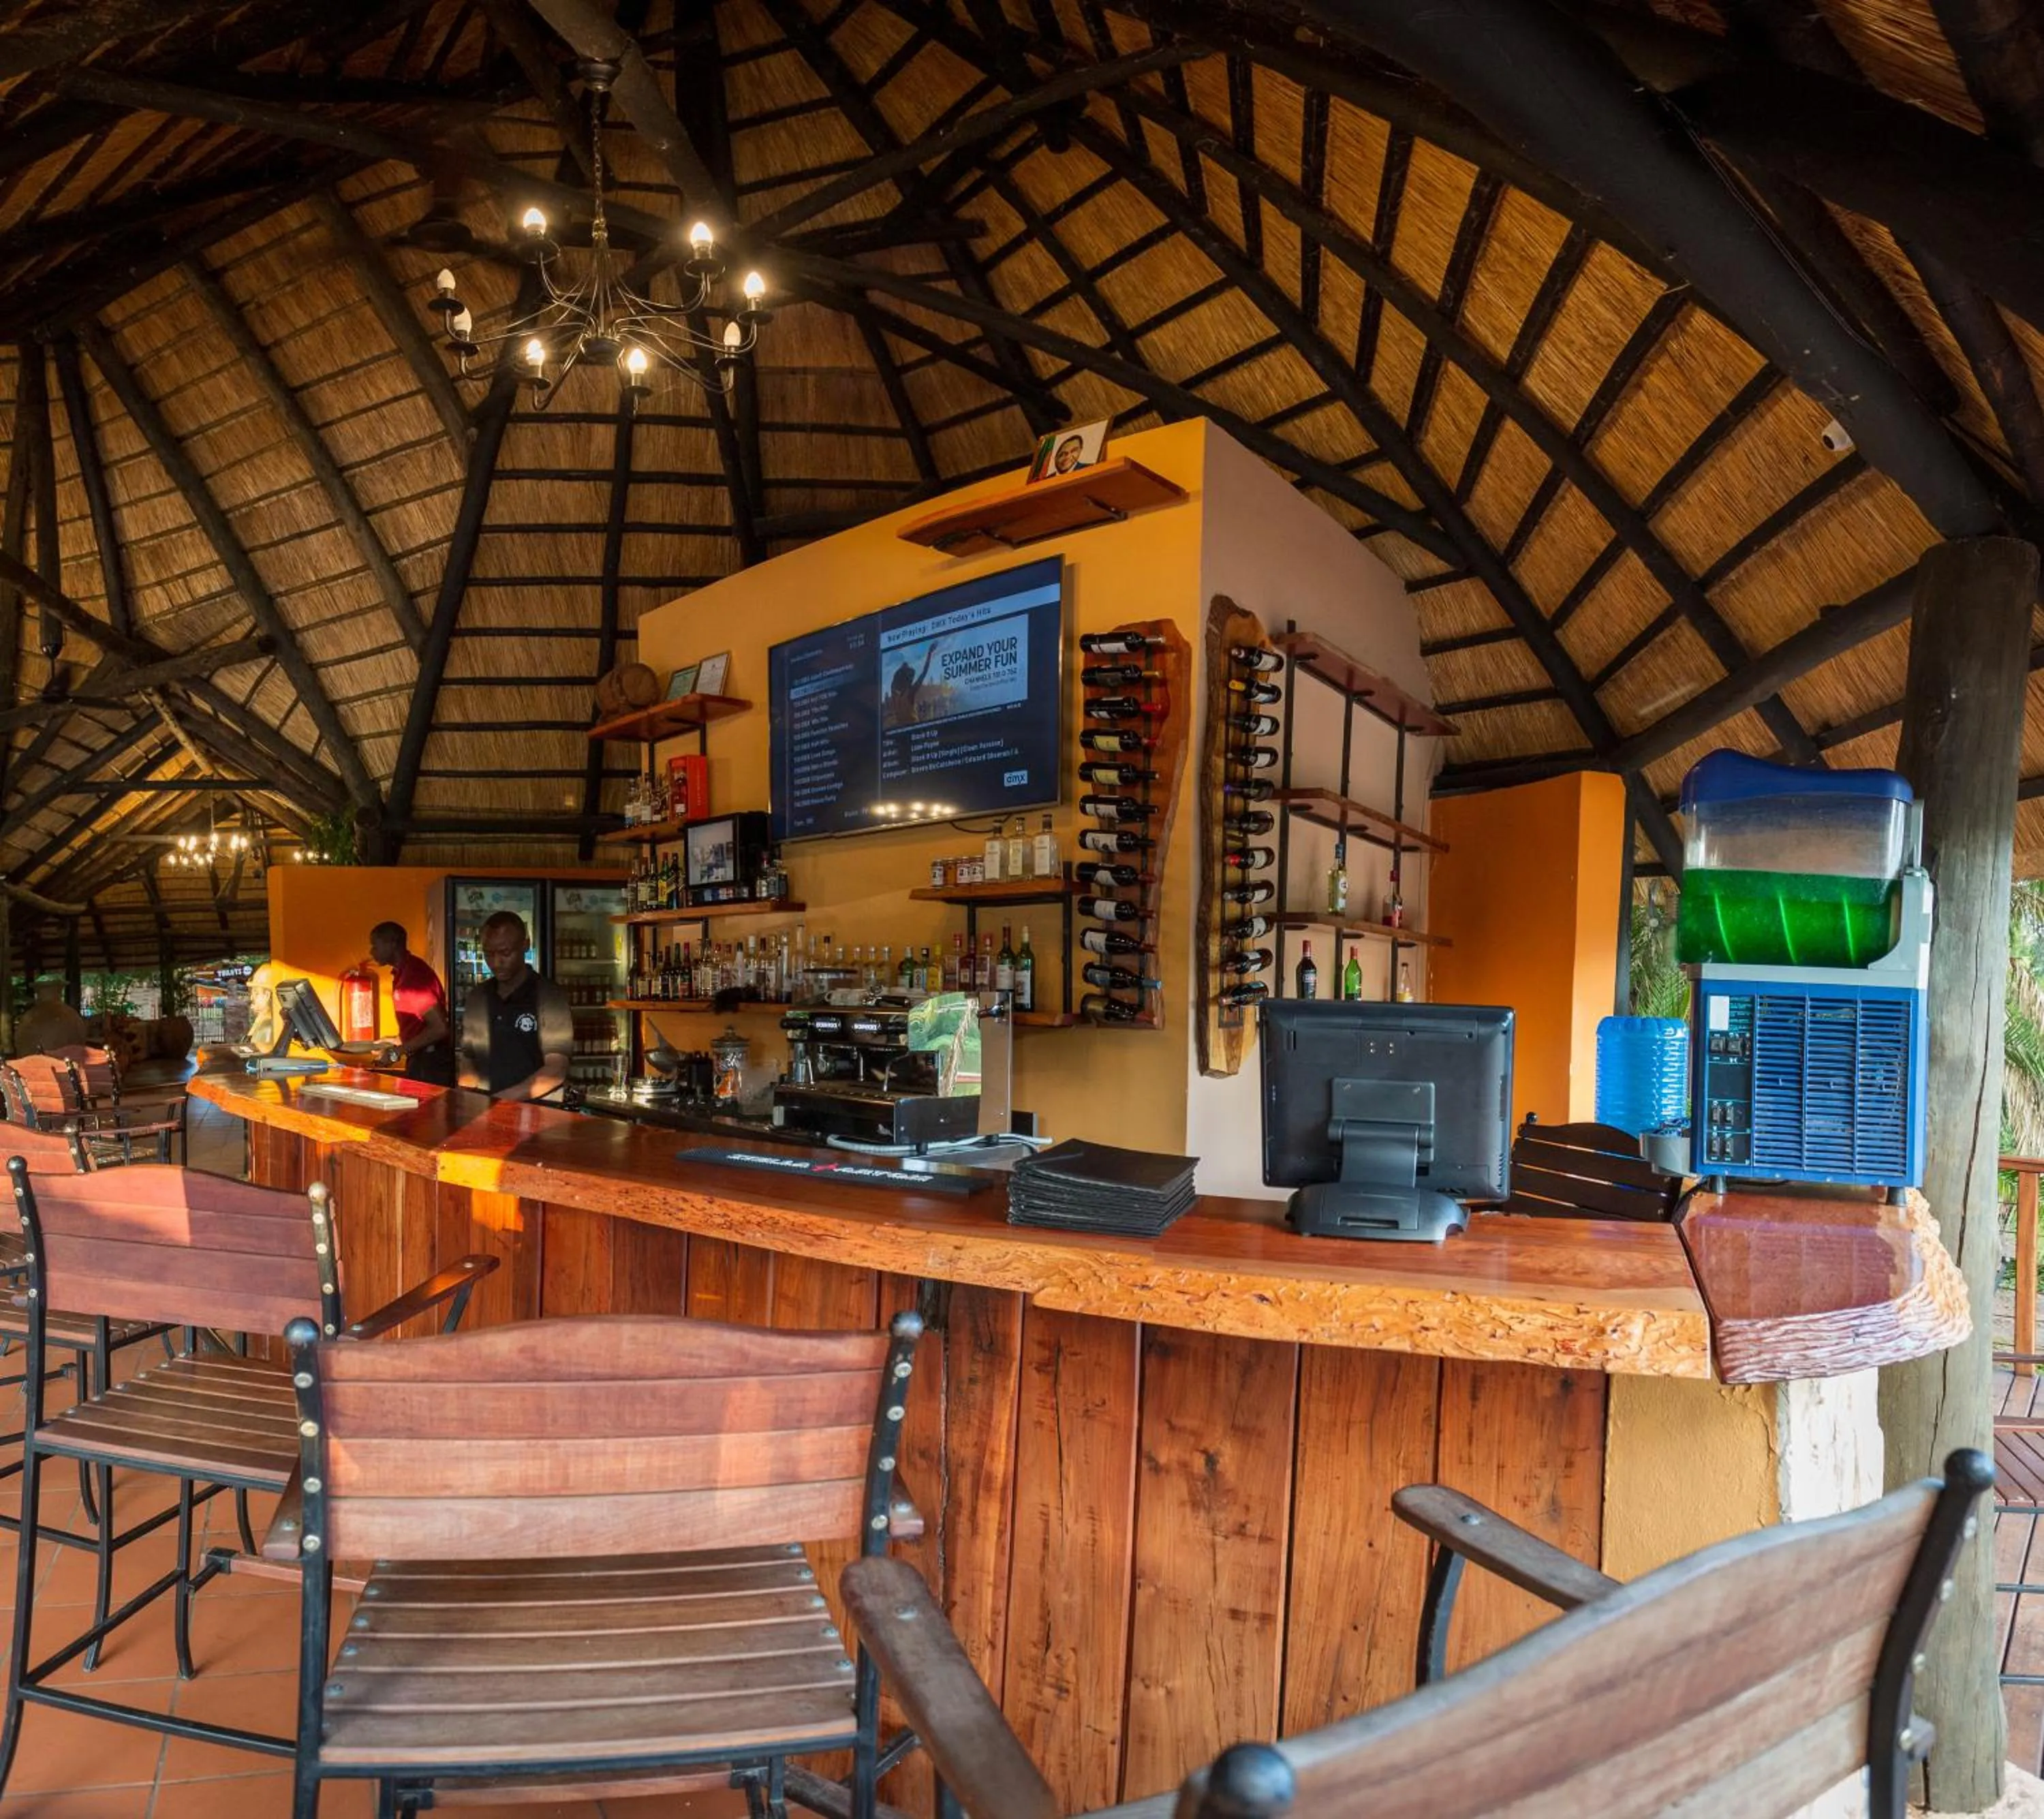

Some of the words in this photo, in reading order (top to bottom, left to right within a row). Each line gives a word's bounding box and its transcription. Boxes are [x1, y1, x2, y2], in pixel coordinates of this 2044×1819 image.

[942, 644, 984, 667] EXPAND
[986, 636, 1017, 655] YOUR
[944, 657, 991, 680] SUMMER
[995, 651, 1017, 668] FUN
